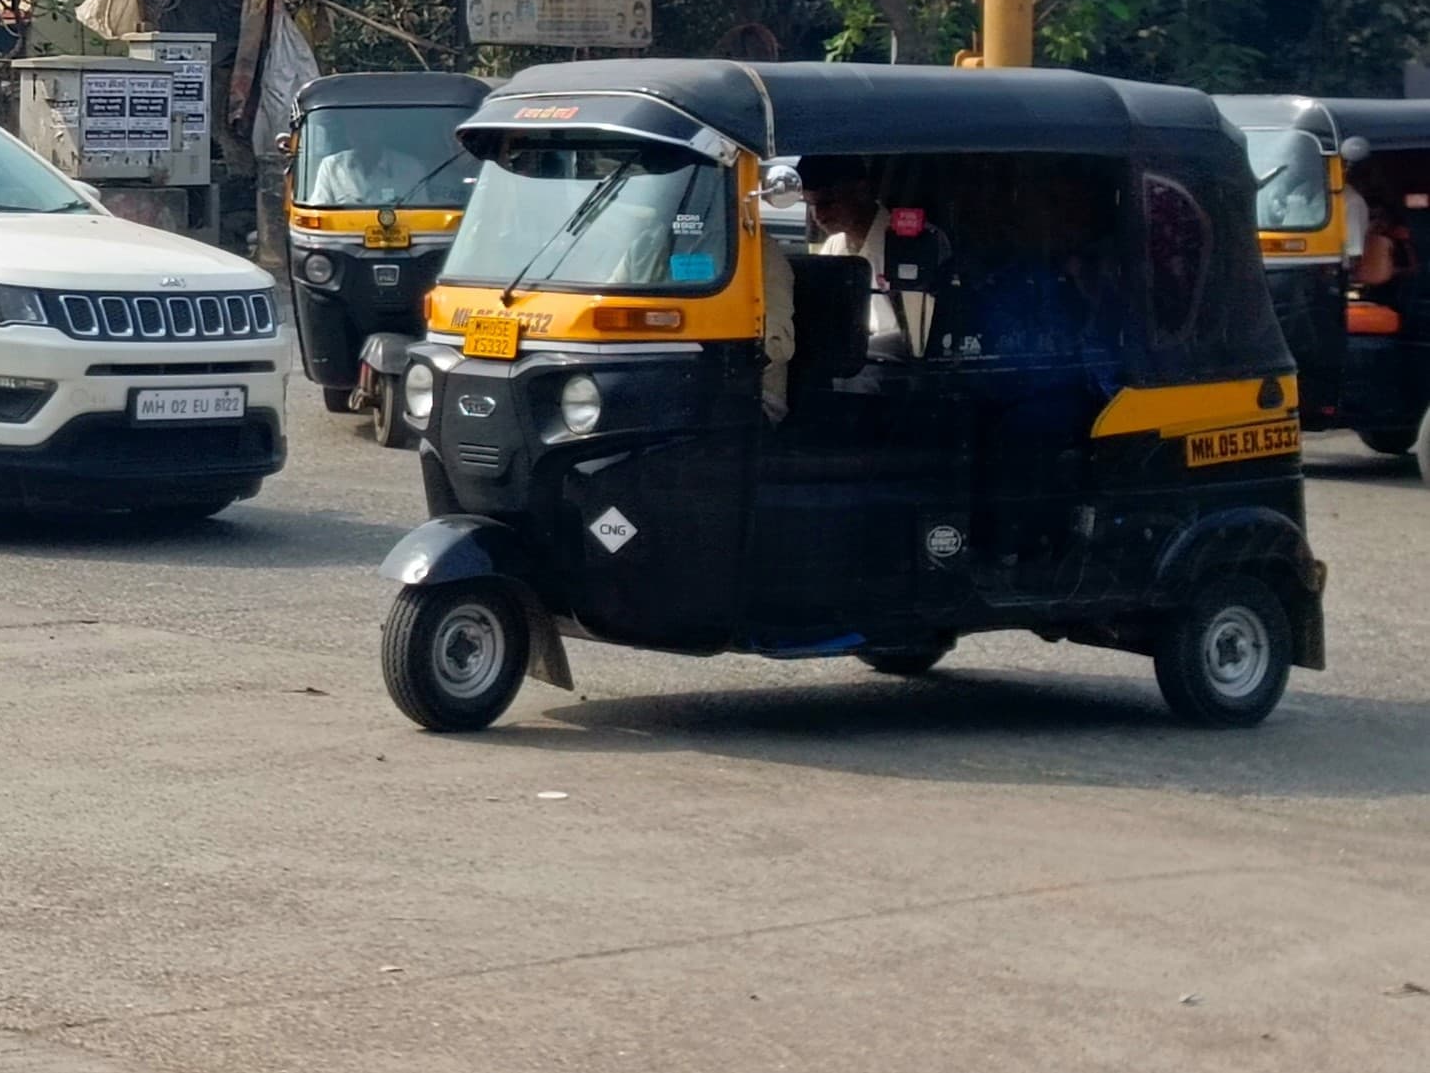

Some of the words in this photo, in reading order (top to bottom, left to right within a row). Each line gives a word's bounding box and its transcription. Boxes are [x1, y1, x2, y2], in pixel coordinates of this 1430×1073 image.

[142, 399, 166, 414] MH
[171, 399, 187, 414] 02
[193, 398, 210, 413] EU
[599, 523, 627, 537] CNG
